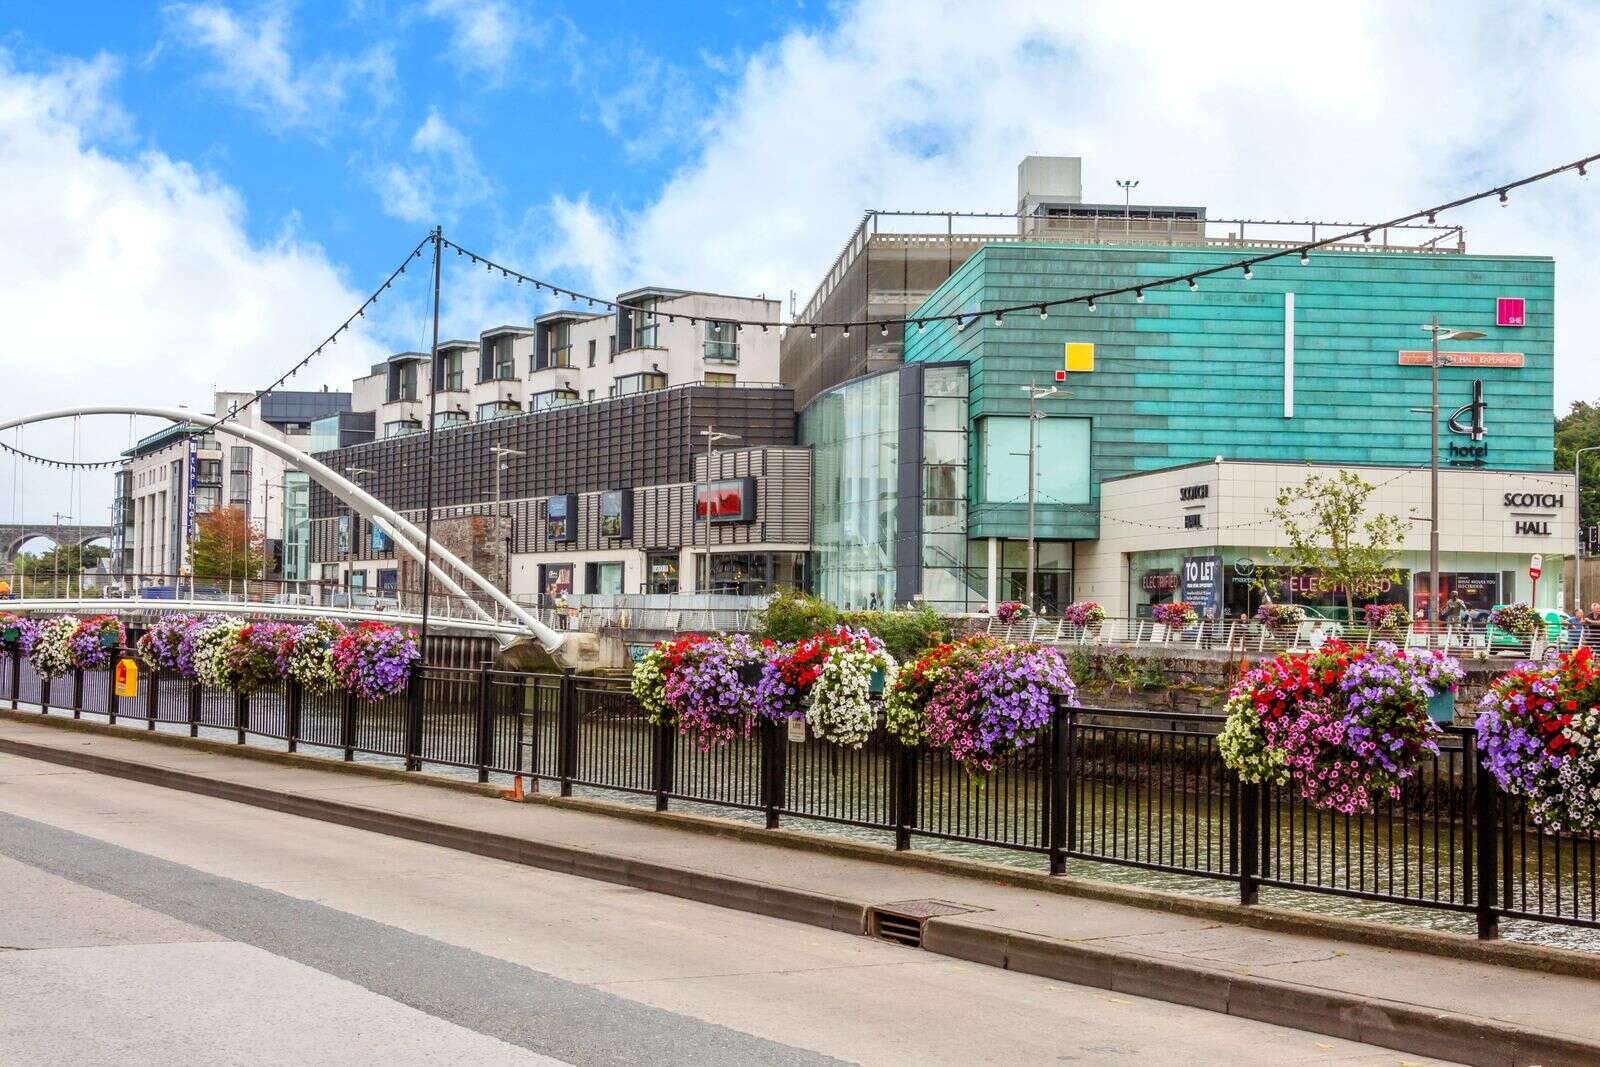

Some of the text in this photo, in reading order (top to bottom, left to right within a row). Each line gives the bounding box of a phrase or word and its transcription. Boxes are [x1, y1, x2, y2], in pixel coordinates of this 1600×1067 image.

[1449, 441, 1488, 457] hotel
[1180, 485, 1208, 501] SCOTCH
[1504, 493, 1563, 507] SCOTCH
[1515, 521, 1552, 535] HALL
[1185, 561, 1215, 581] TO LET
